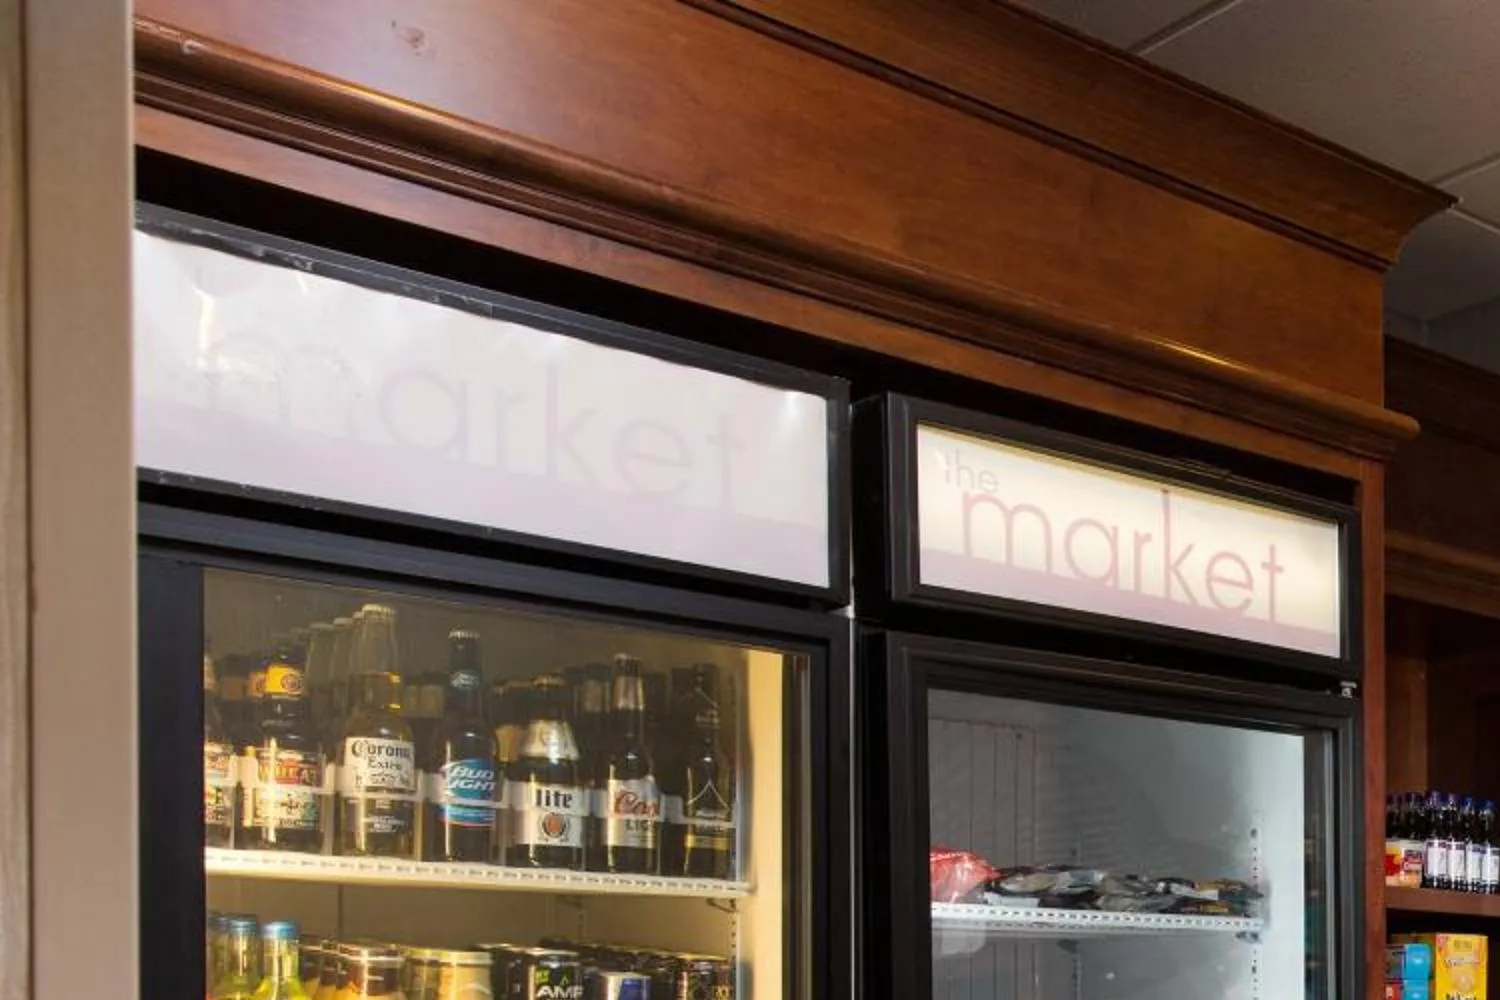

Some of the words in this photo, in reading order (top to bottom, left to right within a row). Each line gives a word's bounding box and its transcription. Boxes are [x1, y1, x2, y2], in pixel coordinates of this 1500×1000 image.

[942, 447, 1000, 492] the
[963, 487, 1285, 623] market
[536, 787, 573, 810] lite
